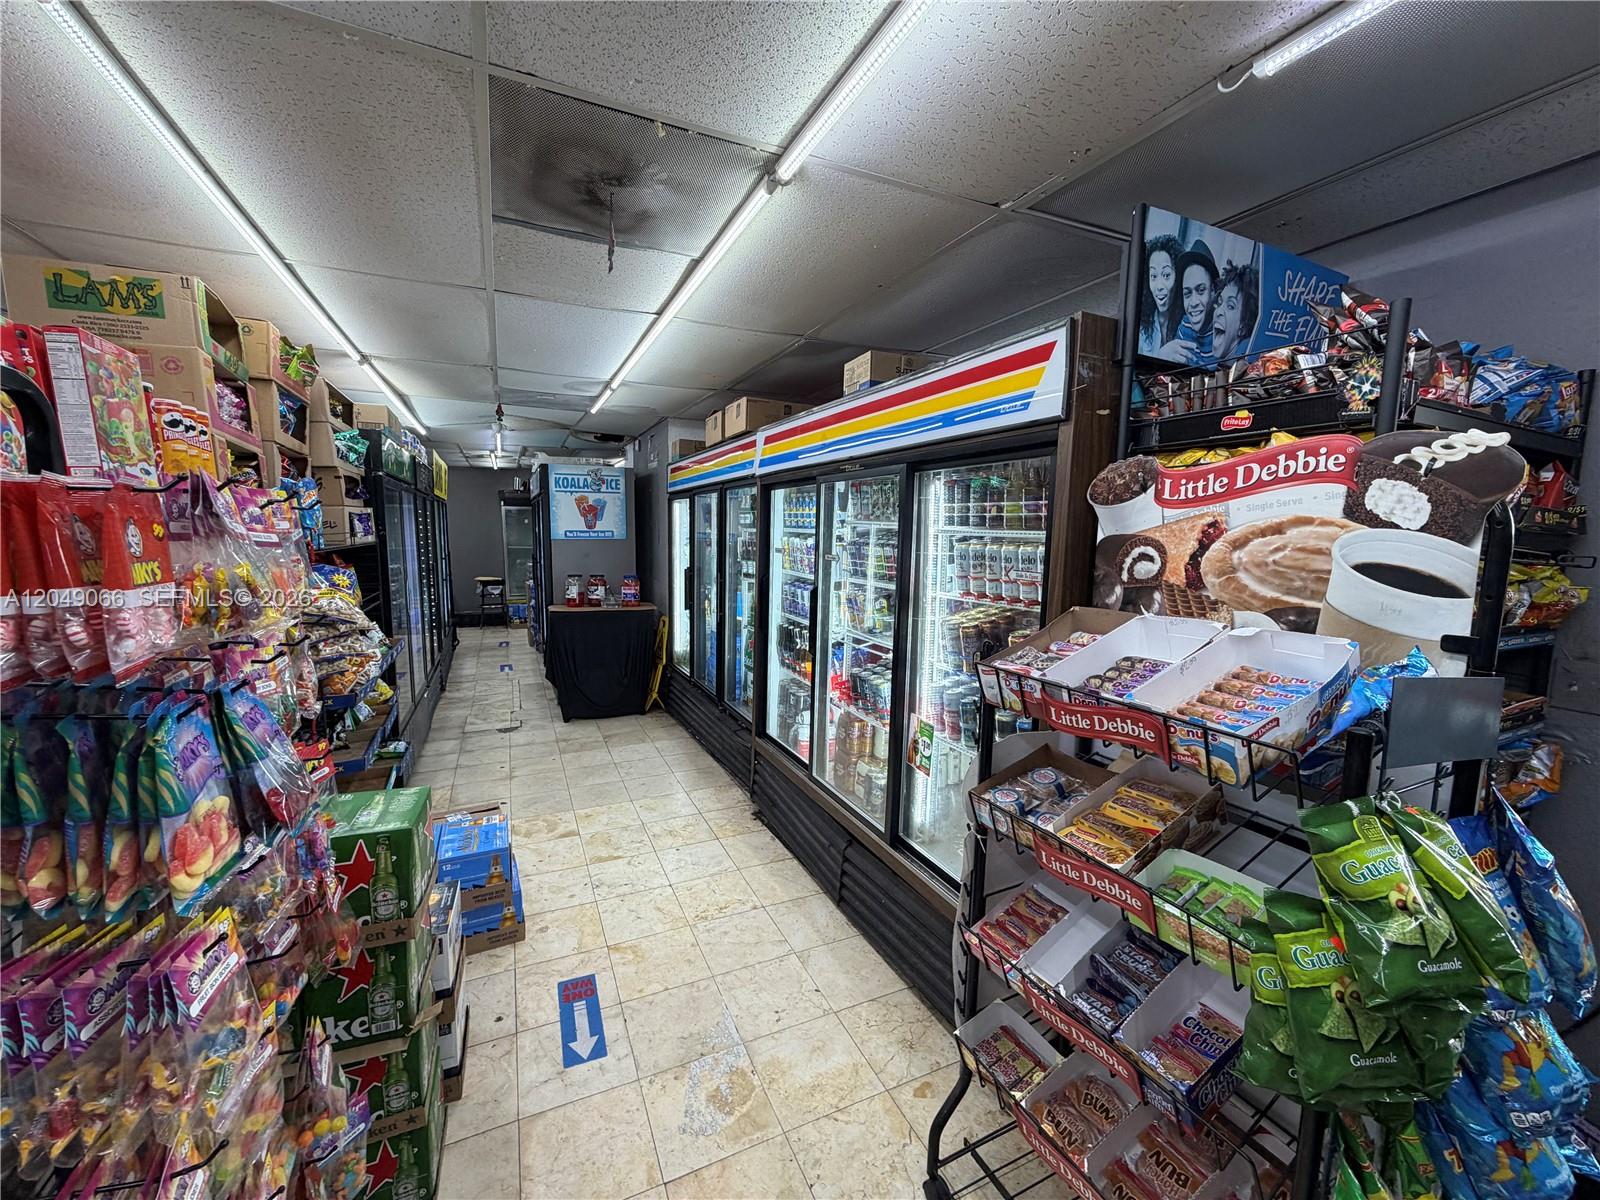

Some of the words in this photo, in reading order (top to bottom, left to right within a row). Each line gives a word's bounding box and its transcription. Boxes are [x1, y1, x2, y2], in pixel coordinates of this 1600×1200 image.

[1268, 309, 1296, 333] THE
[554, 477, 590, 490] KOALA
[605, 479, 622, 491] ICE
[1162, 473, 1229, 501] Little
[1234, 447, 1347, 489] Debbie
[1246, 500, 1274, 513] Single
[1325, 491, 1347, 502] Sing
[1050, 707, 1091, 729] Little
[1093, 715, 1156, 743] Debbie
[1041, 849, 1081, 882] Little
[1082, 869, 1143, 912] Debbie
[1418, 958, 1464, 974] Guacamole
[563, 979, 593, 994] WAY
[563, 988, 595, 1004] ONE
[1031, 998, 1070, 1034] Little
[1070, 1030, 1130, 1079] Debbie
[1350, 1053, 1399, 1070] Guacamole
[1082, 1091, 1117, 1122] BUN
[1044, 1108, 1080, 1150] BUN
[1021, 1123, 1058, 1164] Little
